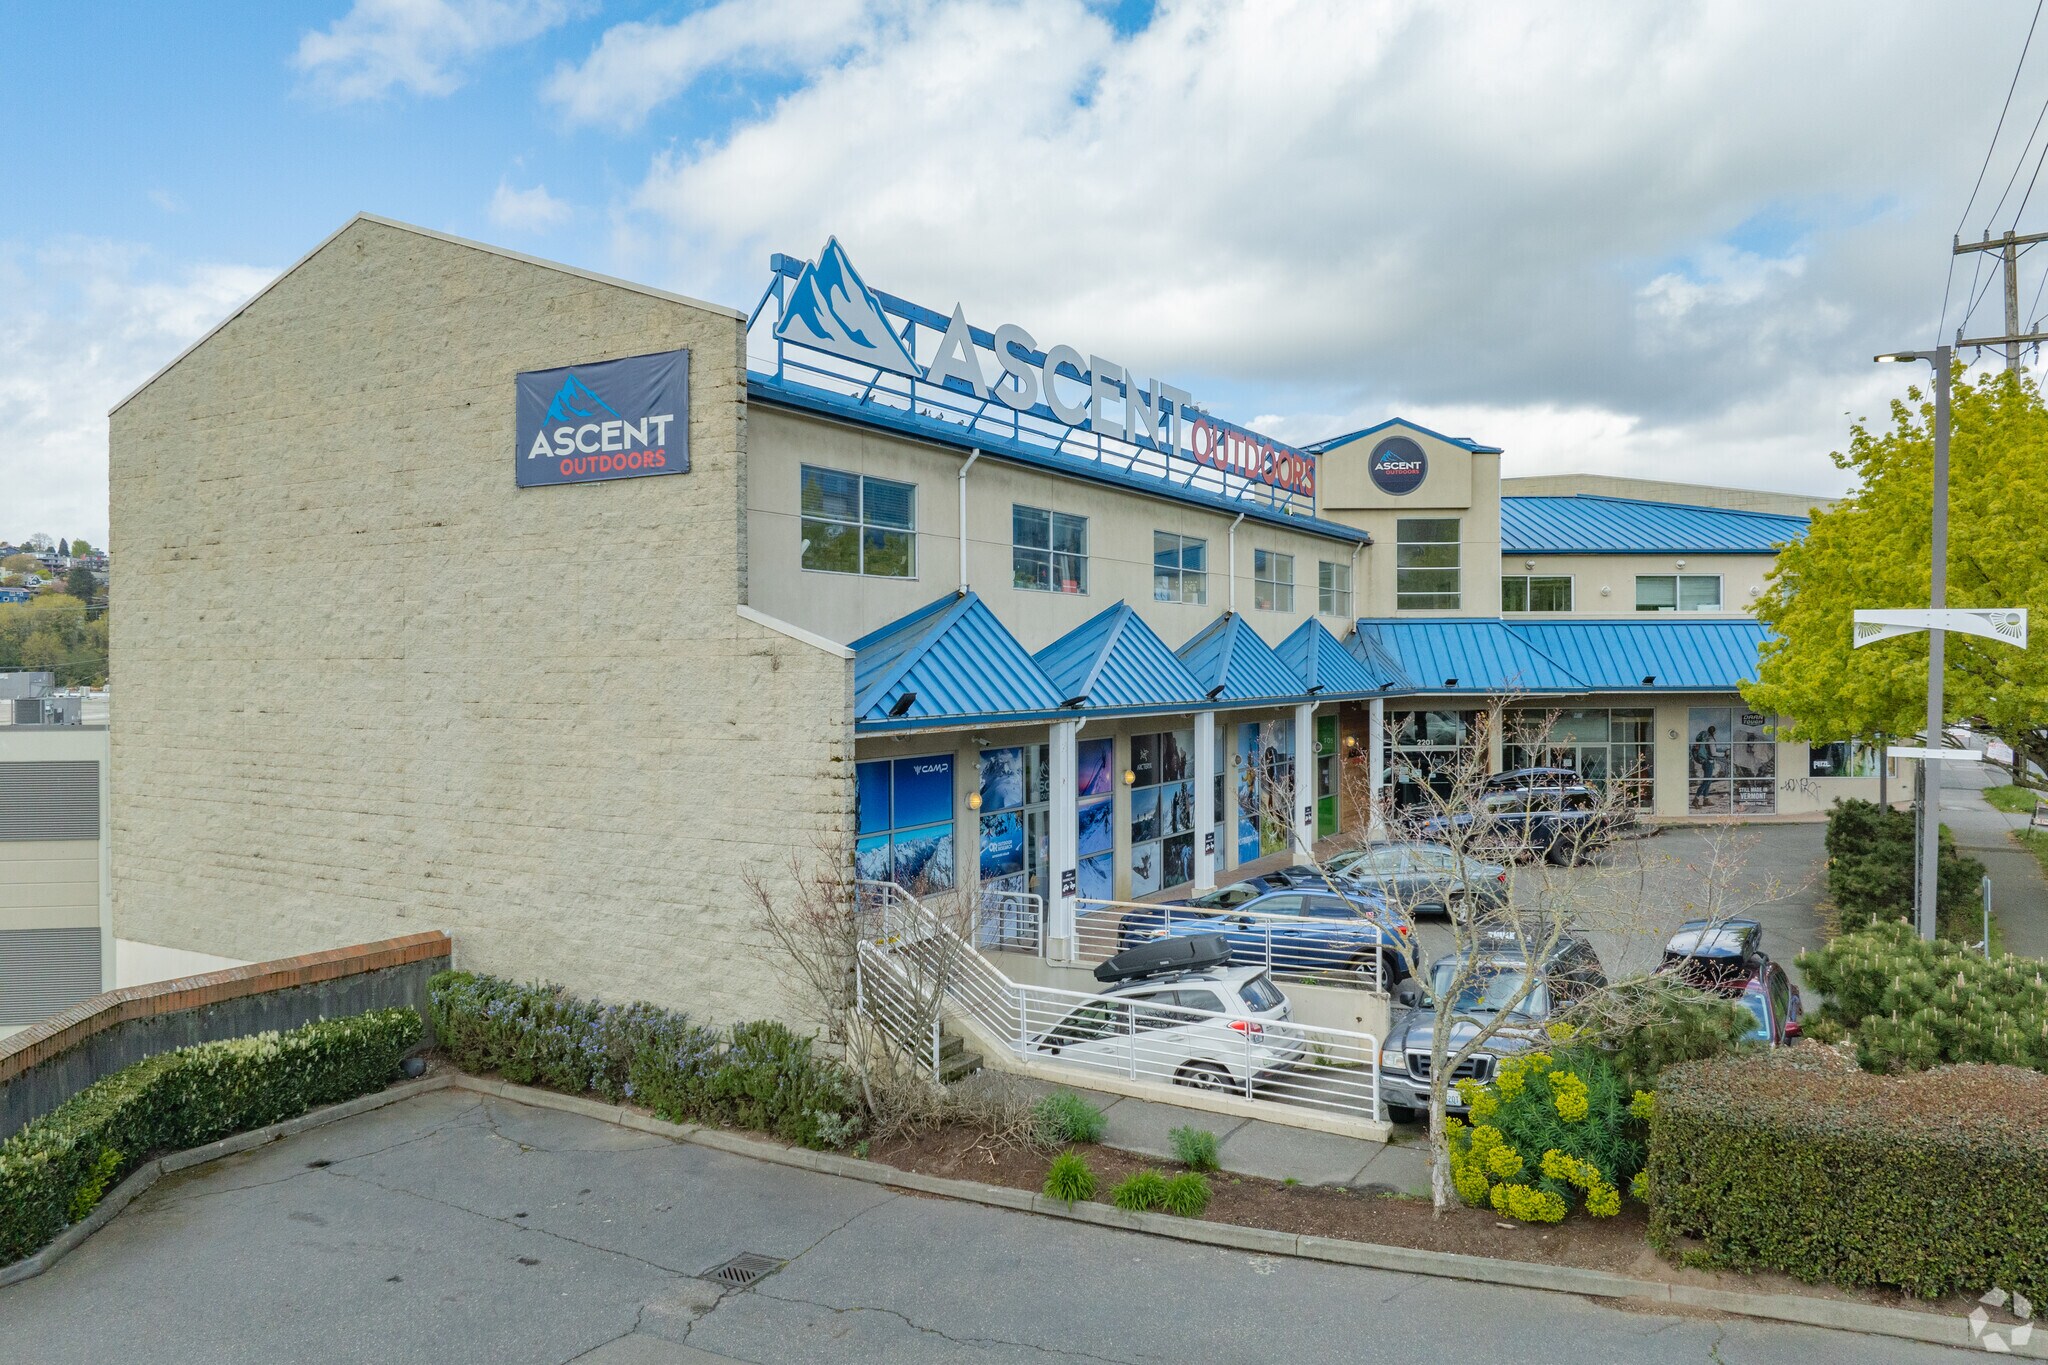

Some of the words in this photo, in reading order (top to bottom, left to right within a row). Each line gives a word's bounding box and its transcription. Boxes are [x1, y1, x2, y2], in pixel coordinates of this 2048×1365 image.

[926, 301, 1192, 457] ASCENT
[528, 414, 674, 459] ASCENT
[560, 449, 666, 476] OUTDOORS
[1191, 417, 1315, 498] OUTDOORS
[1375, 461, 1421, 470] ASCENT
[922, 763, 949, 773] CAMP
[1740, 792, 1767, 800] VERMONT
